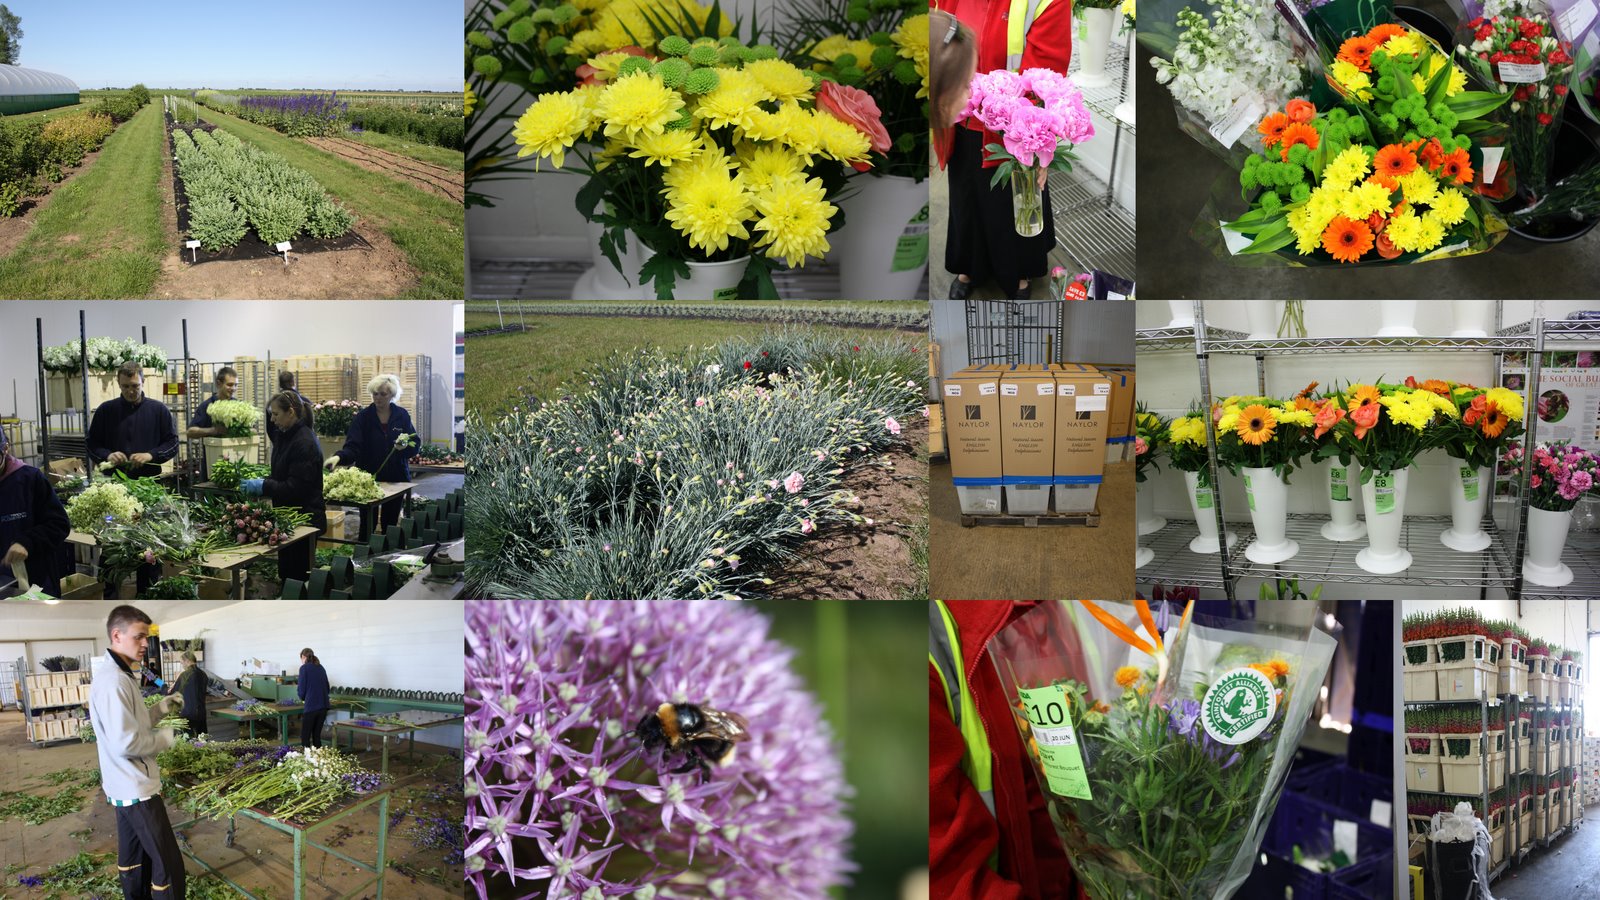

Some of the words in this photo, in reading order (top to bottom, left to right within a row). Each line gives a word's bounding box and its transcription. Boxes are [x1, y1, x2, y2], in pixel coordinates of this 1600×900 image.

[1549, 374, 1582, 383] SOCIAL
[1460, 470, 1471, 478] £8
[1375, 479, 1386, 487] £8
[1213, 683, 1234, 723] RAINFOREST
[1235, 680, 1262, 698] ALLIANCE
[1229, 711, 1263, 735] CERTIFIED
